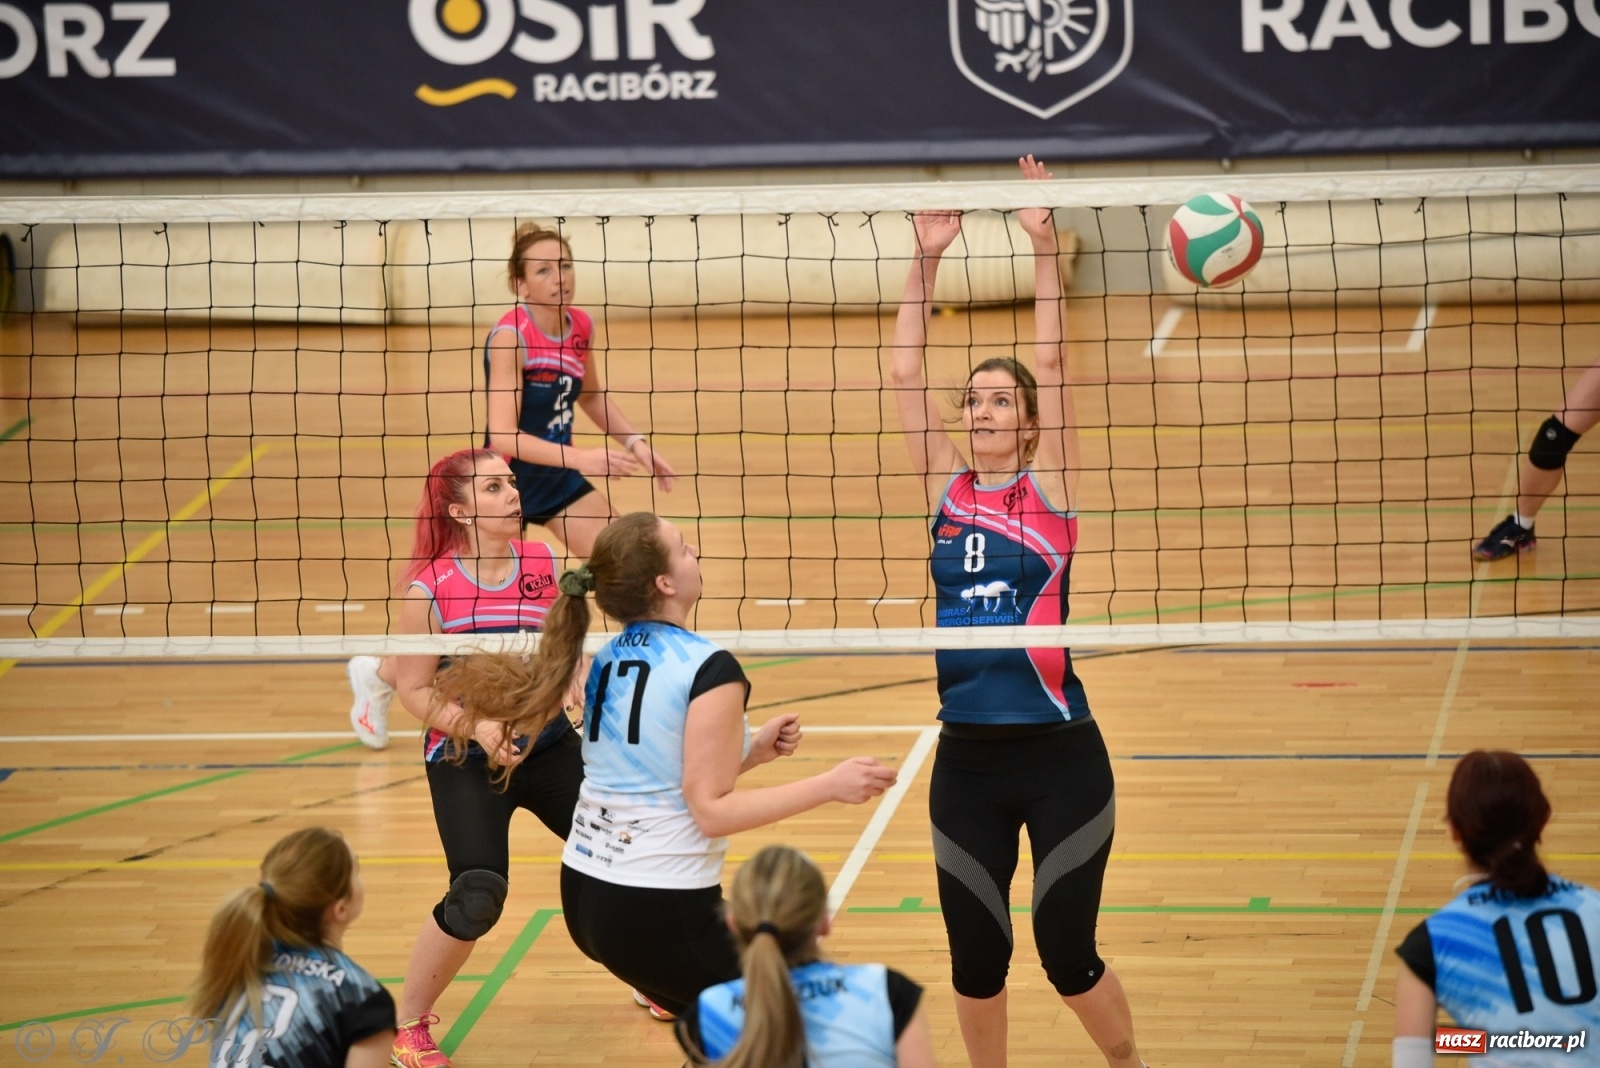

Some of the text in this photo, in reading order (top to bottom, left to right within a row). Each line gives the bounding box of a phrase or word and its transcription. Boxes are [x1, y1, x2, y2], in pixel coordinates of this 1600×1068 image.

[1240, 0, 1600, 53] RACIB
[533, 64, 718, 101] RACIBÓRZ
[964, 532, 986, 573] 8
[615, 627, 651, 648] KRÓL
[588, 660, 651, 745] 17
[1493, 907, 1598, 1014] 10
